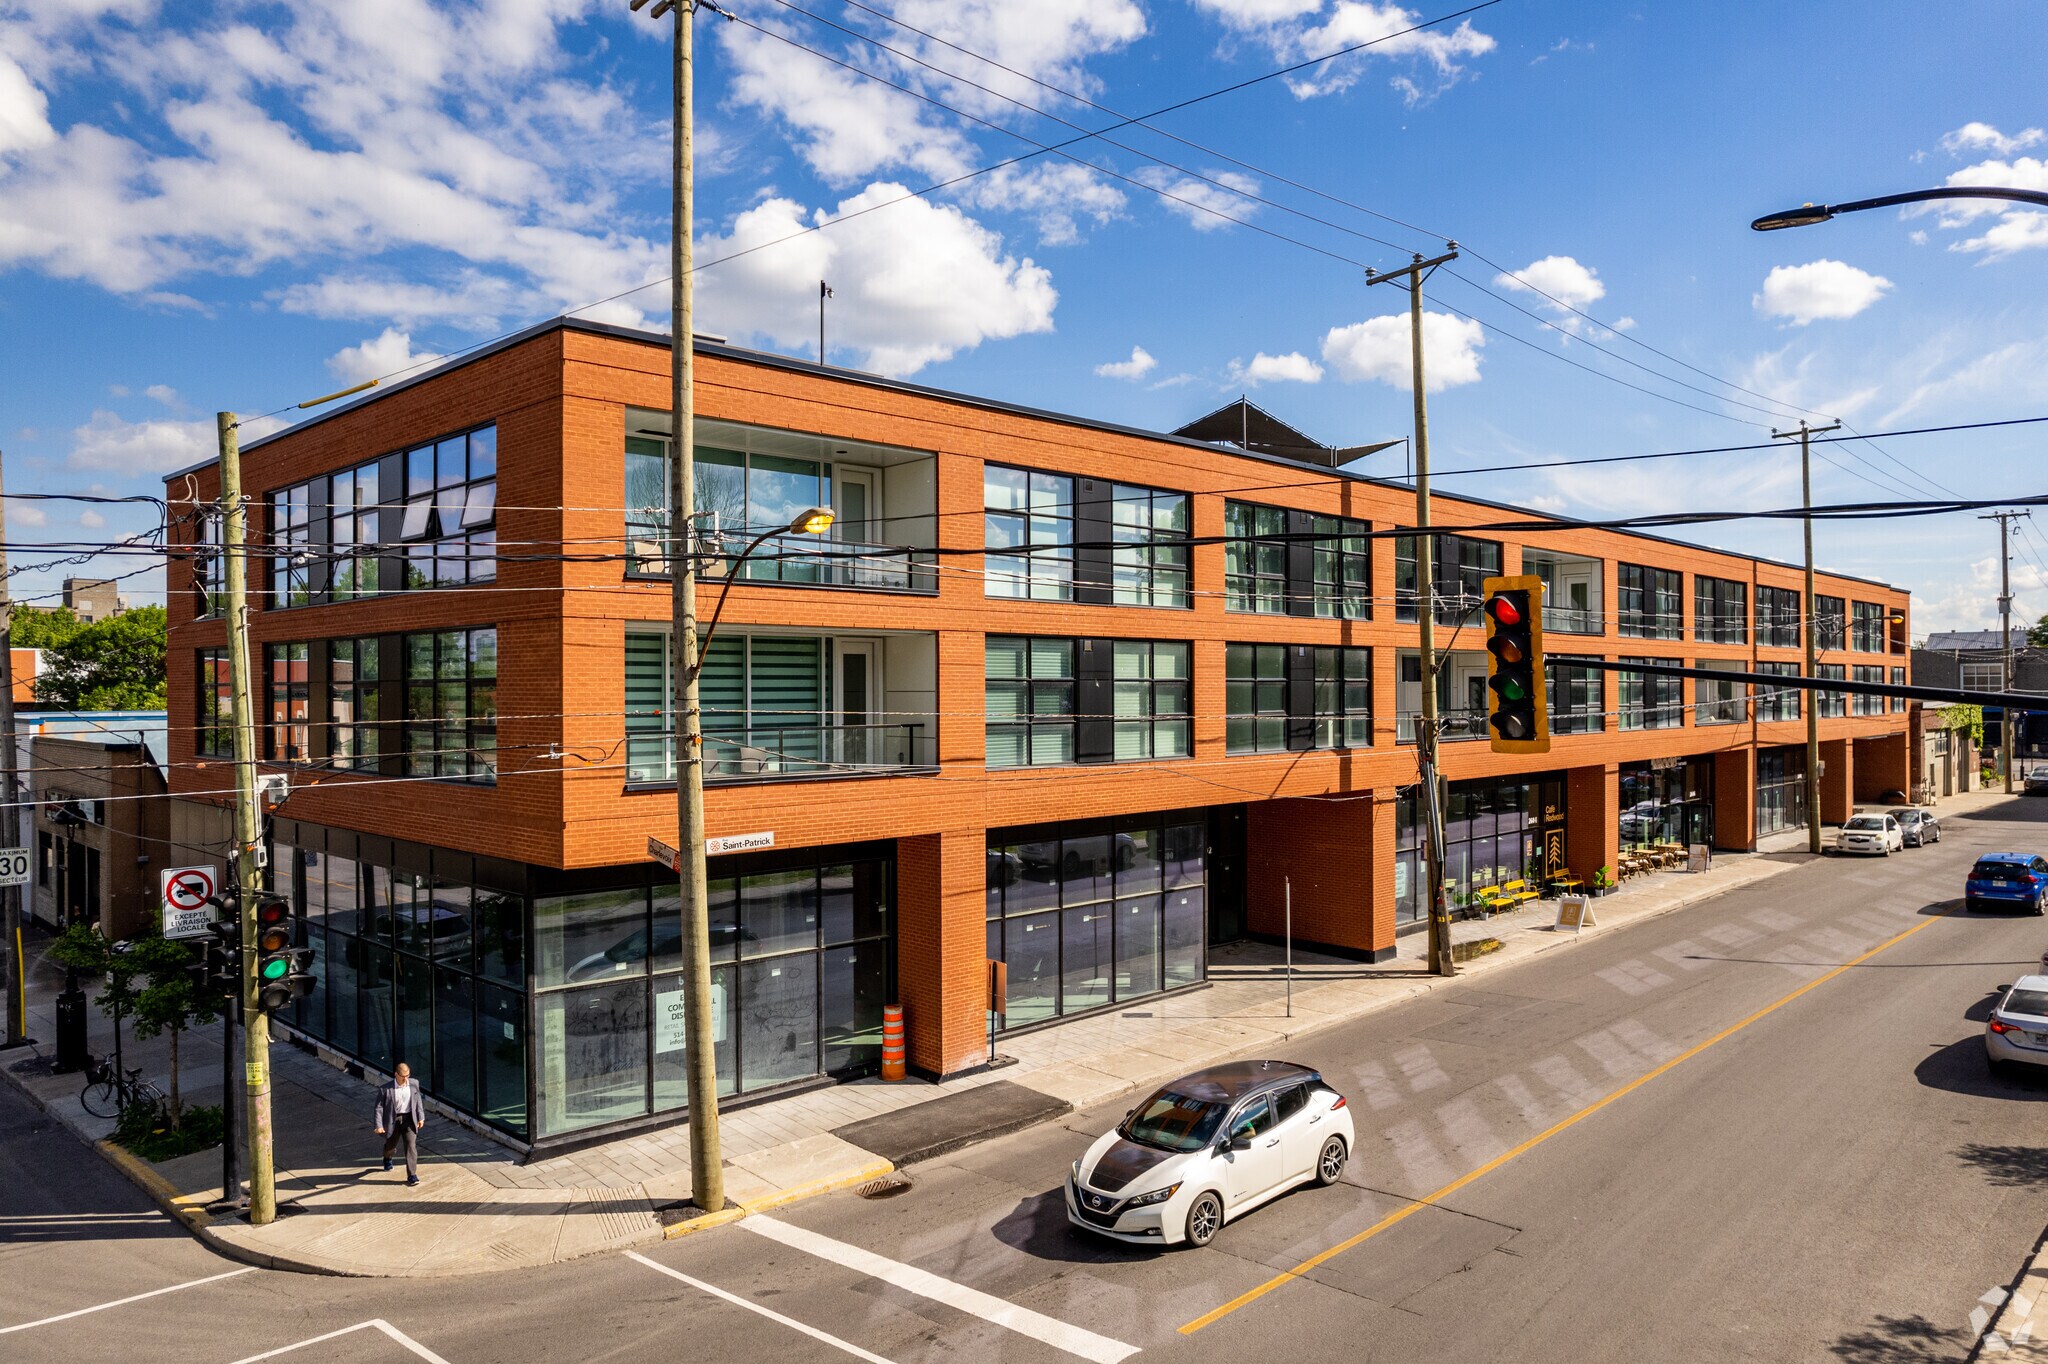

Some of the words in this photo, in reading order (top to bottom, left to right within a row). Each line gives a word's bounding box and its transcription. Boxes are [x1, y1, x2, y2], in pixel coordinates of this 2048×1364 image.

[722, 837, 771, 850] Saint-Patrick
[648, 844, 673, 864] Charlevoix
[0, 856, 27, 876] 30
[174, 911, 208, 921] EXCEPTÉ
[171, 917, 211, 927] LIVRAISON
[177, 924, 206, 933] LOCALE
